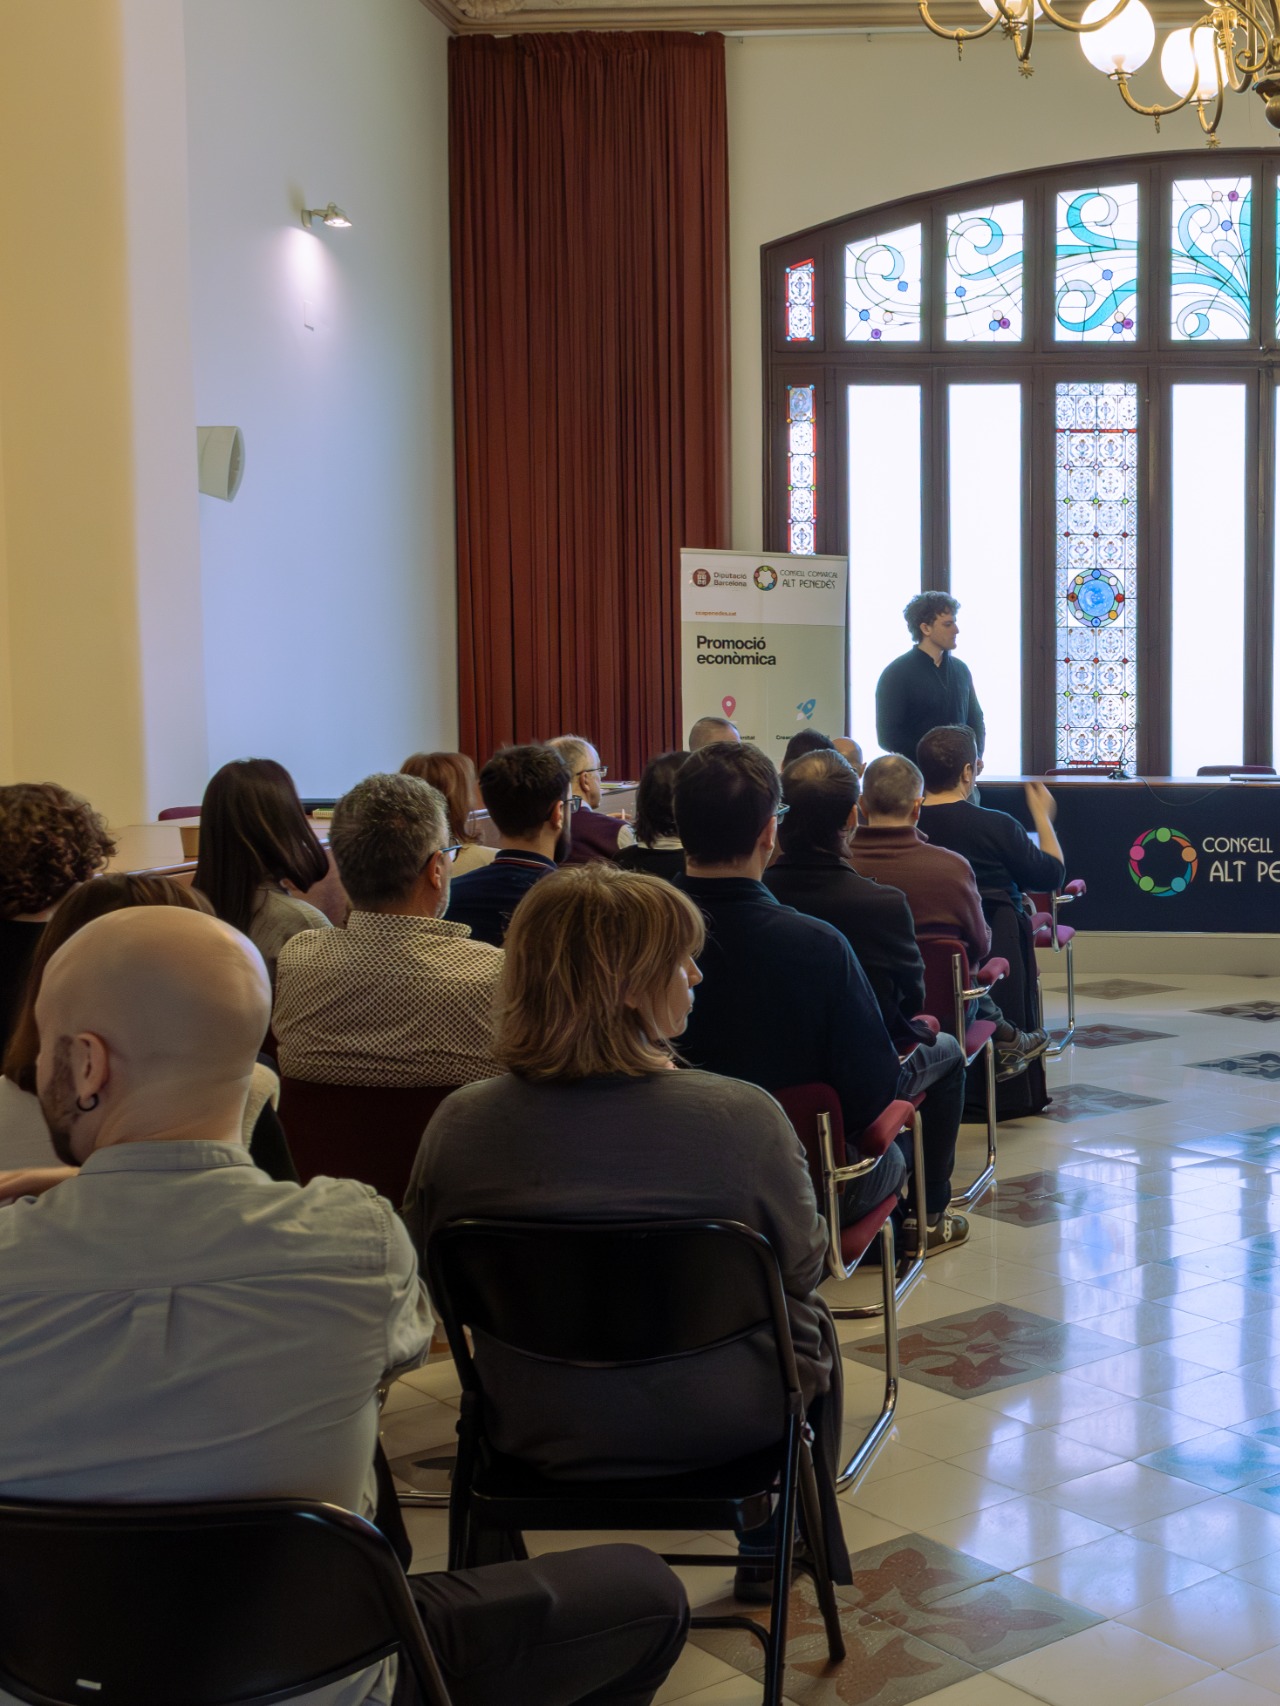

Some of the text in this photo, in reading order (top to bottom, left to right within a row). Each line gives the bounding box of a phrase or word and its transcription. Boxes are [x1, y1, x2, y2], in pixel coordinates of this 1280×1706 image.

[714, 572, 747, 580] Diputació
[782, 579, 796, 587] ALT
[696, 635, 767, 650] Promoció
[696, 651, 777, 666] econòmica
[1202, 837, 1274, 853] CONSELL
[1209, 860, 1247, 882] ALT
